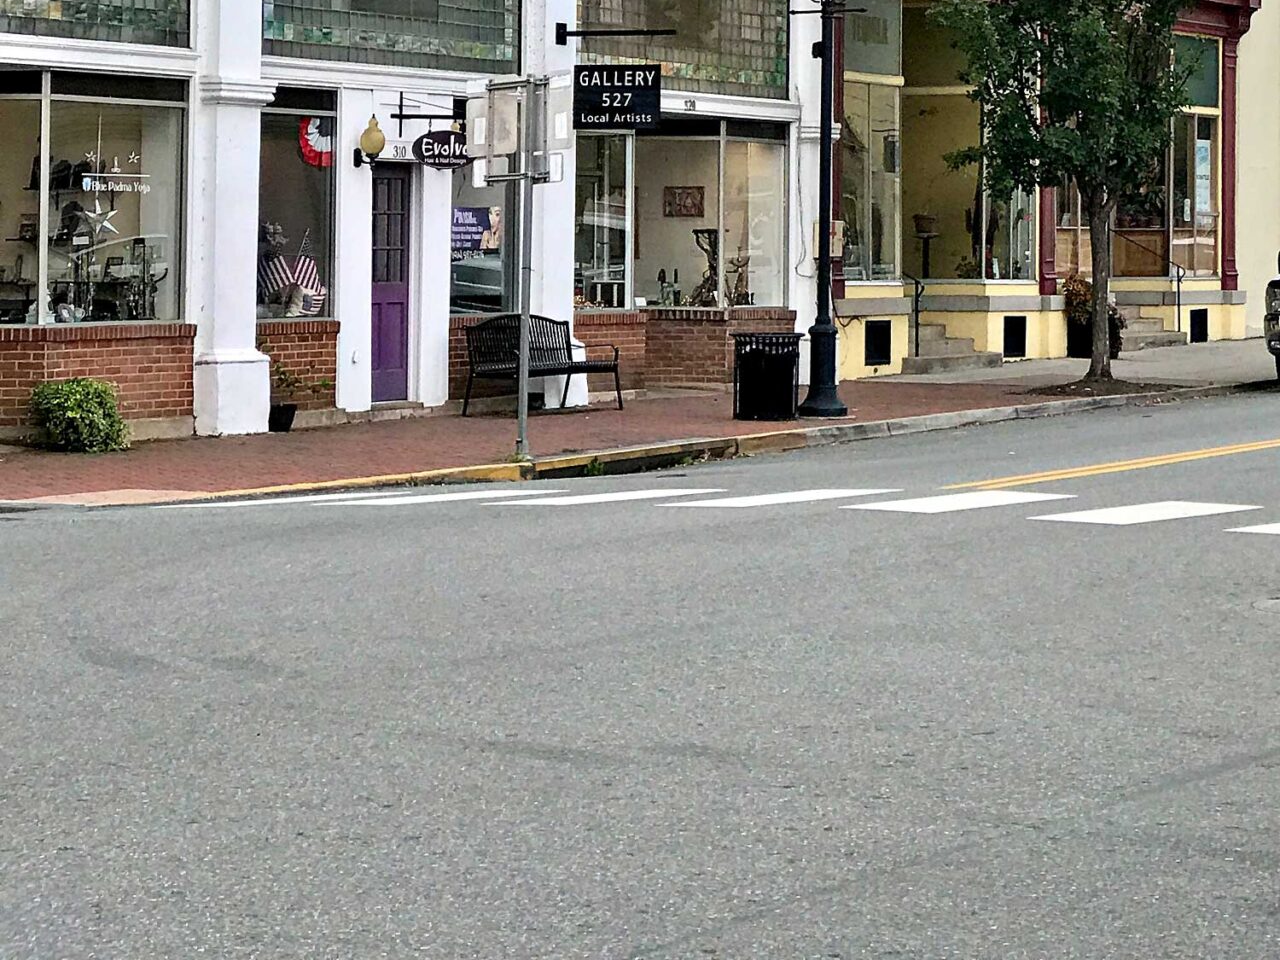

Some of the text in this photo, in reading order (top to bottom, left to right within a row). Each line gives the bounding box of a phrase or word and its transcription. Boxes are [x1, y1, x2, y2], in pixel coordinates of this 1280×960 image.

[579, 71, 656, 86] GALLERY
[601, 92, 632, 107] 527
[581, 113, 652, 123] Local Artists
[393, 145, 407, 158] 310
[92, 180, 151, 194] Blue Padma Yoga
